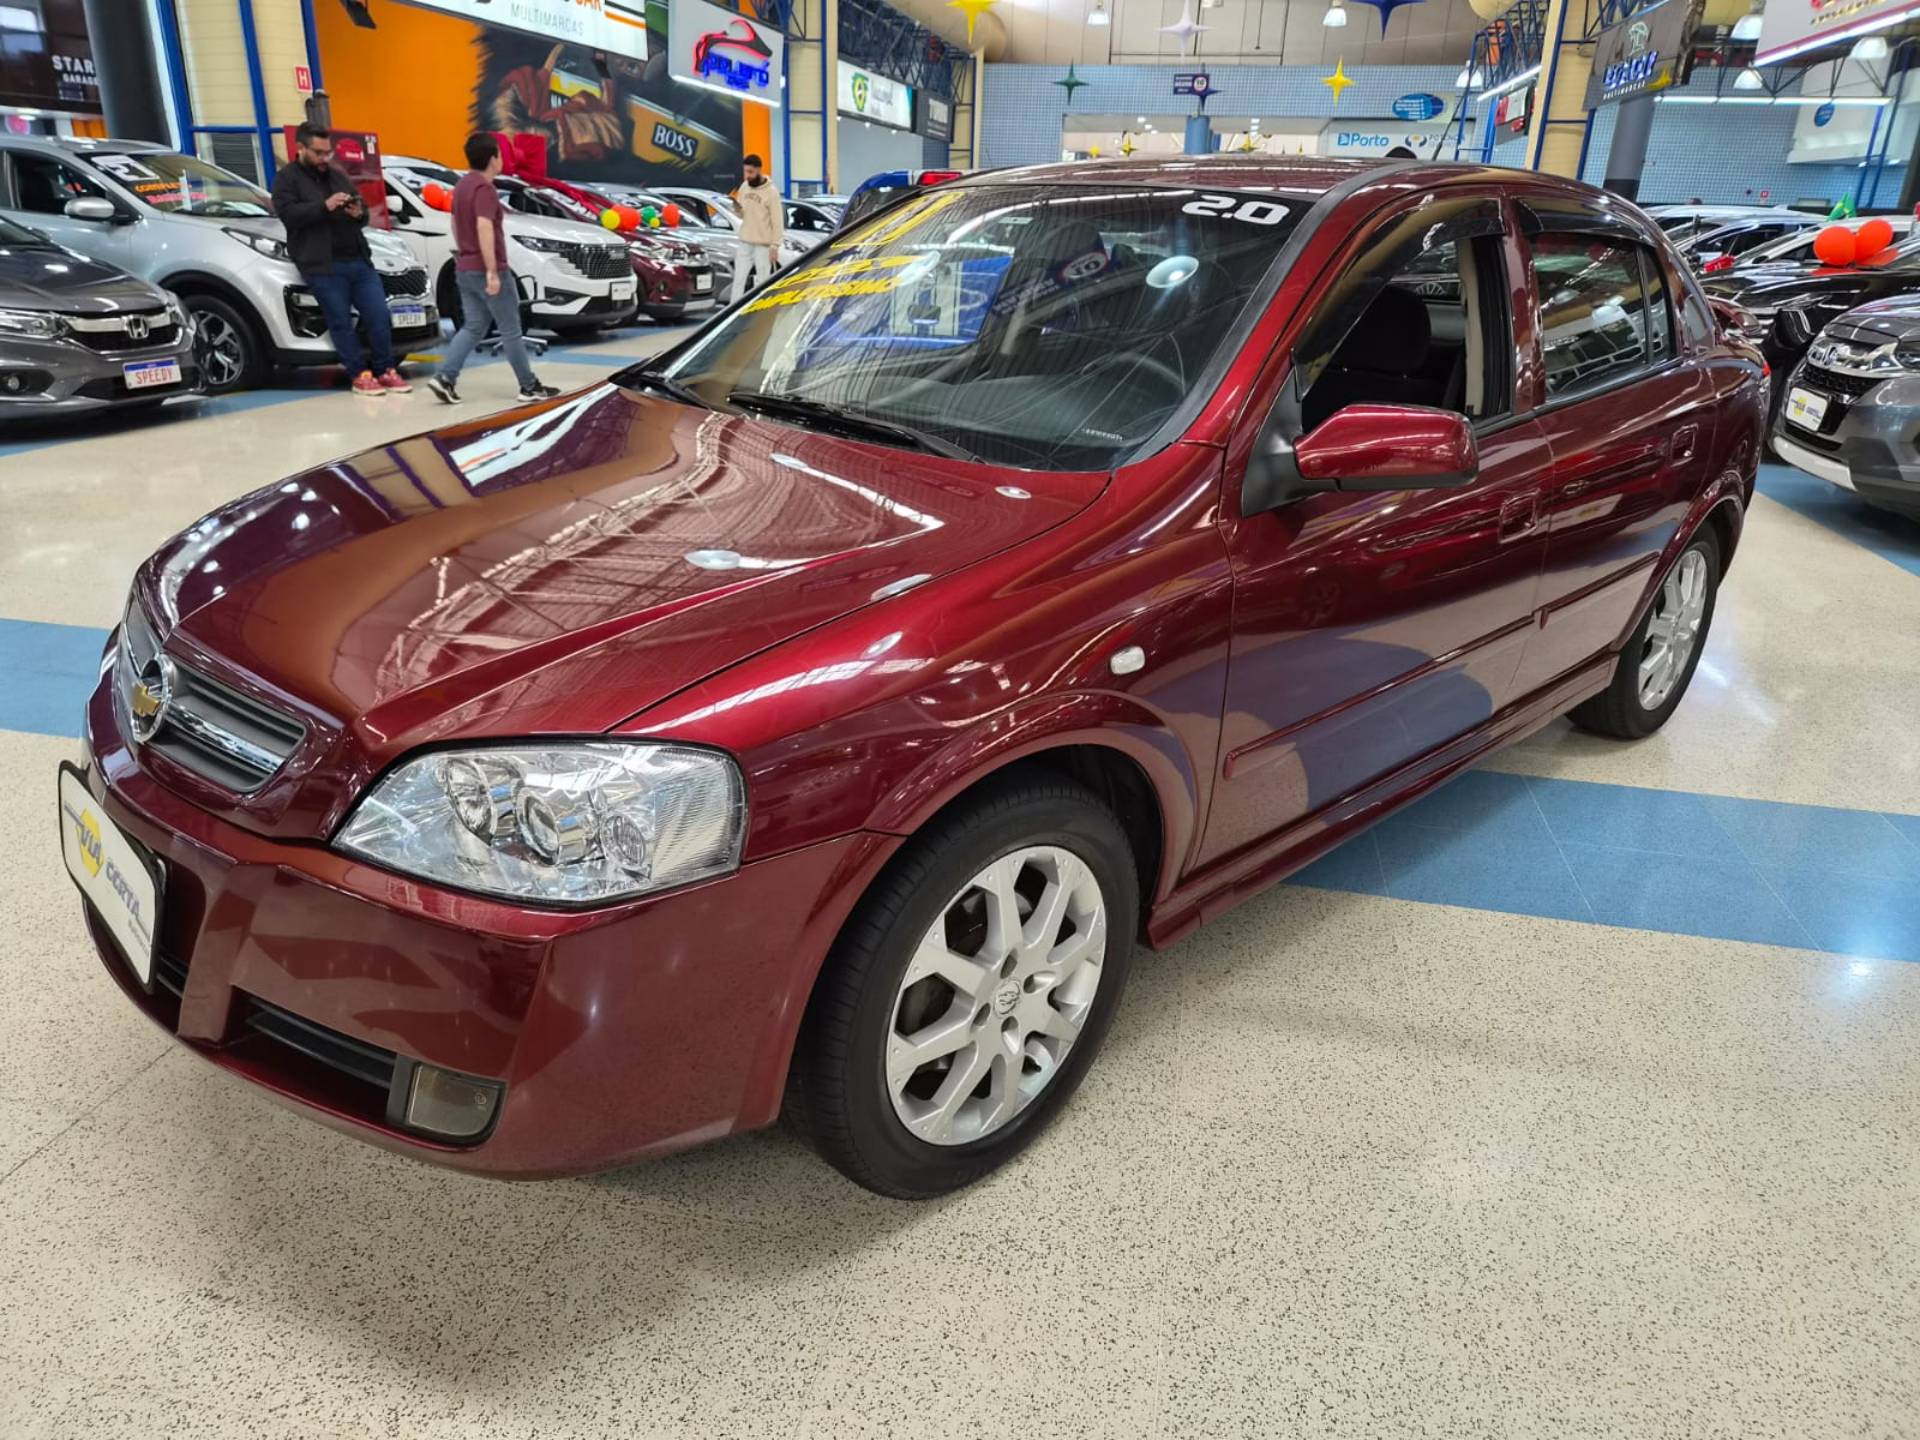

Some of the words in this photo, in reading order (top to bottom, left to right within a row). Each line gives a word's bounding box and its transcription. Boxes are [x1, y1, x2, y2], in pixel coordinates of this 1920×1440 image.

[510, 3, 584, 36] MULTIMARCAS
[52, 54, 95, 74] STAR
[298, 69, 310, 89] H
[654, 124, 696, 158] BOSS
[1350, 132, 1390, 146] Porto
[1181, 194, 1290, 226] 2.0
[136, 367, 173, 385] SPEEDY
[80, 824, 102, 865] VIA
[105, 859, 141, 916] CERTA
